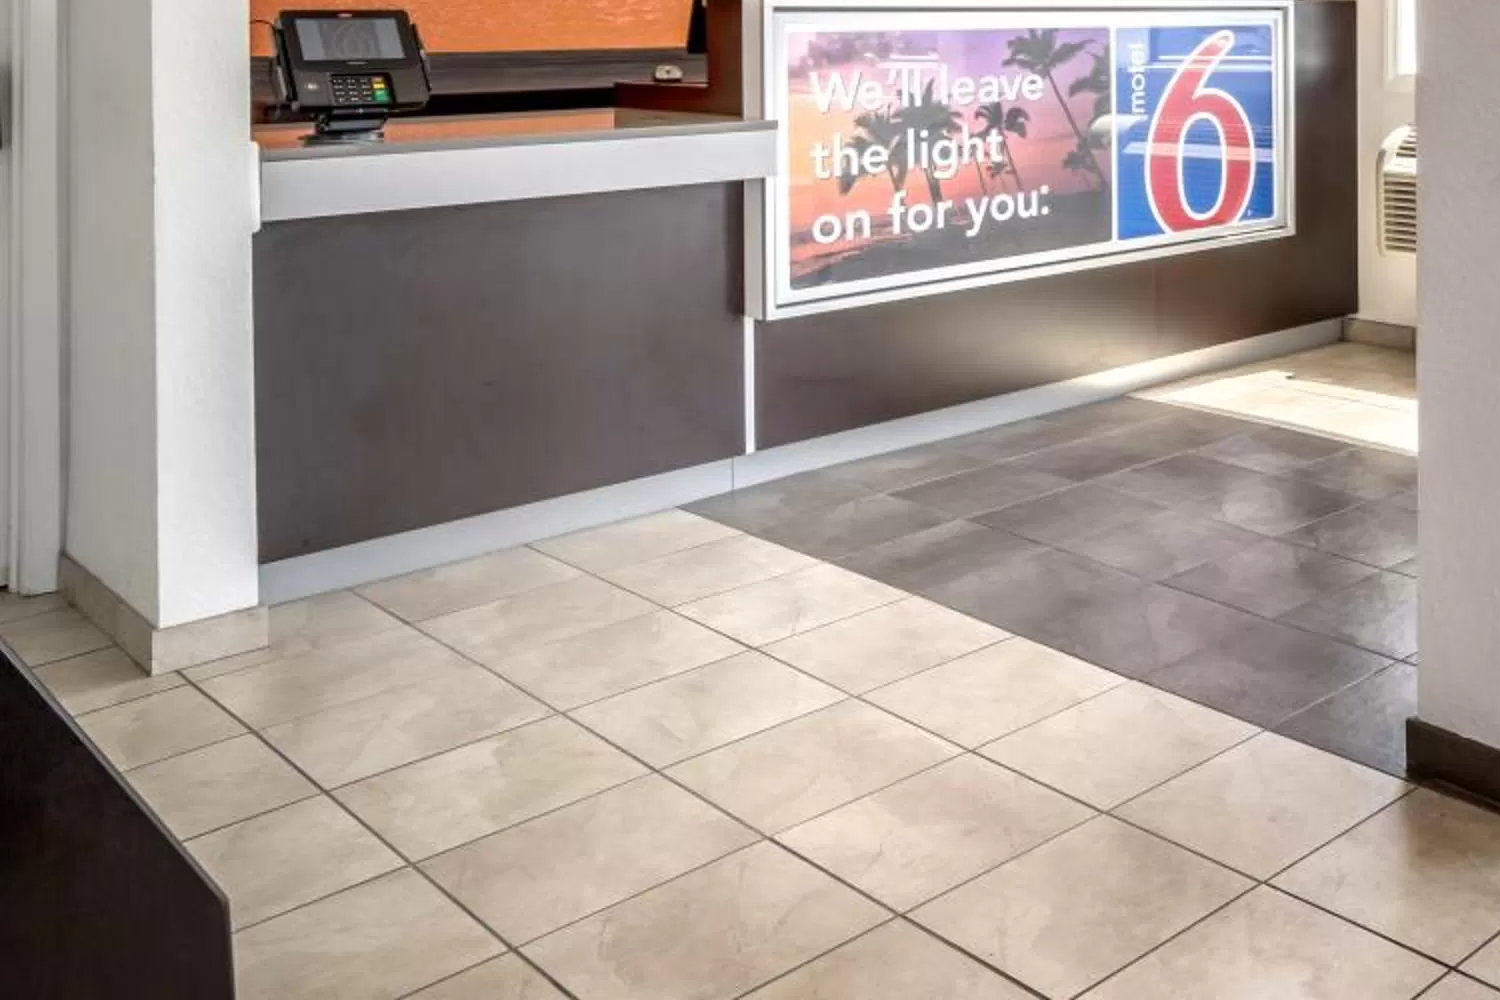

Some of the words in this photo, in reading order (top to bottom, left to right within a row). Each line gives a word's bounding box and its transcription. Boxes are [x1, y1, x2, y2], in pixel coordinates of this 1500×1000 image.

[809, 64, 922, 113] We'll
[940, 63, 1045, 105] leave
[1127, 43, 1146, 116] motel
[811, 132, 889, 179] the
[907, 122, 1004, 180] light
[1144, 29, 1256, 235] 6
[811, 208, 871, 244] on
[888, 190, 953, 235] for
